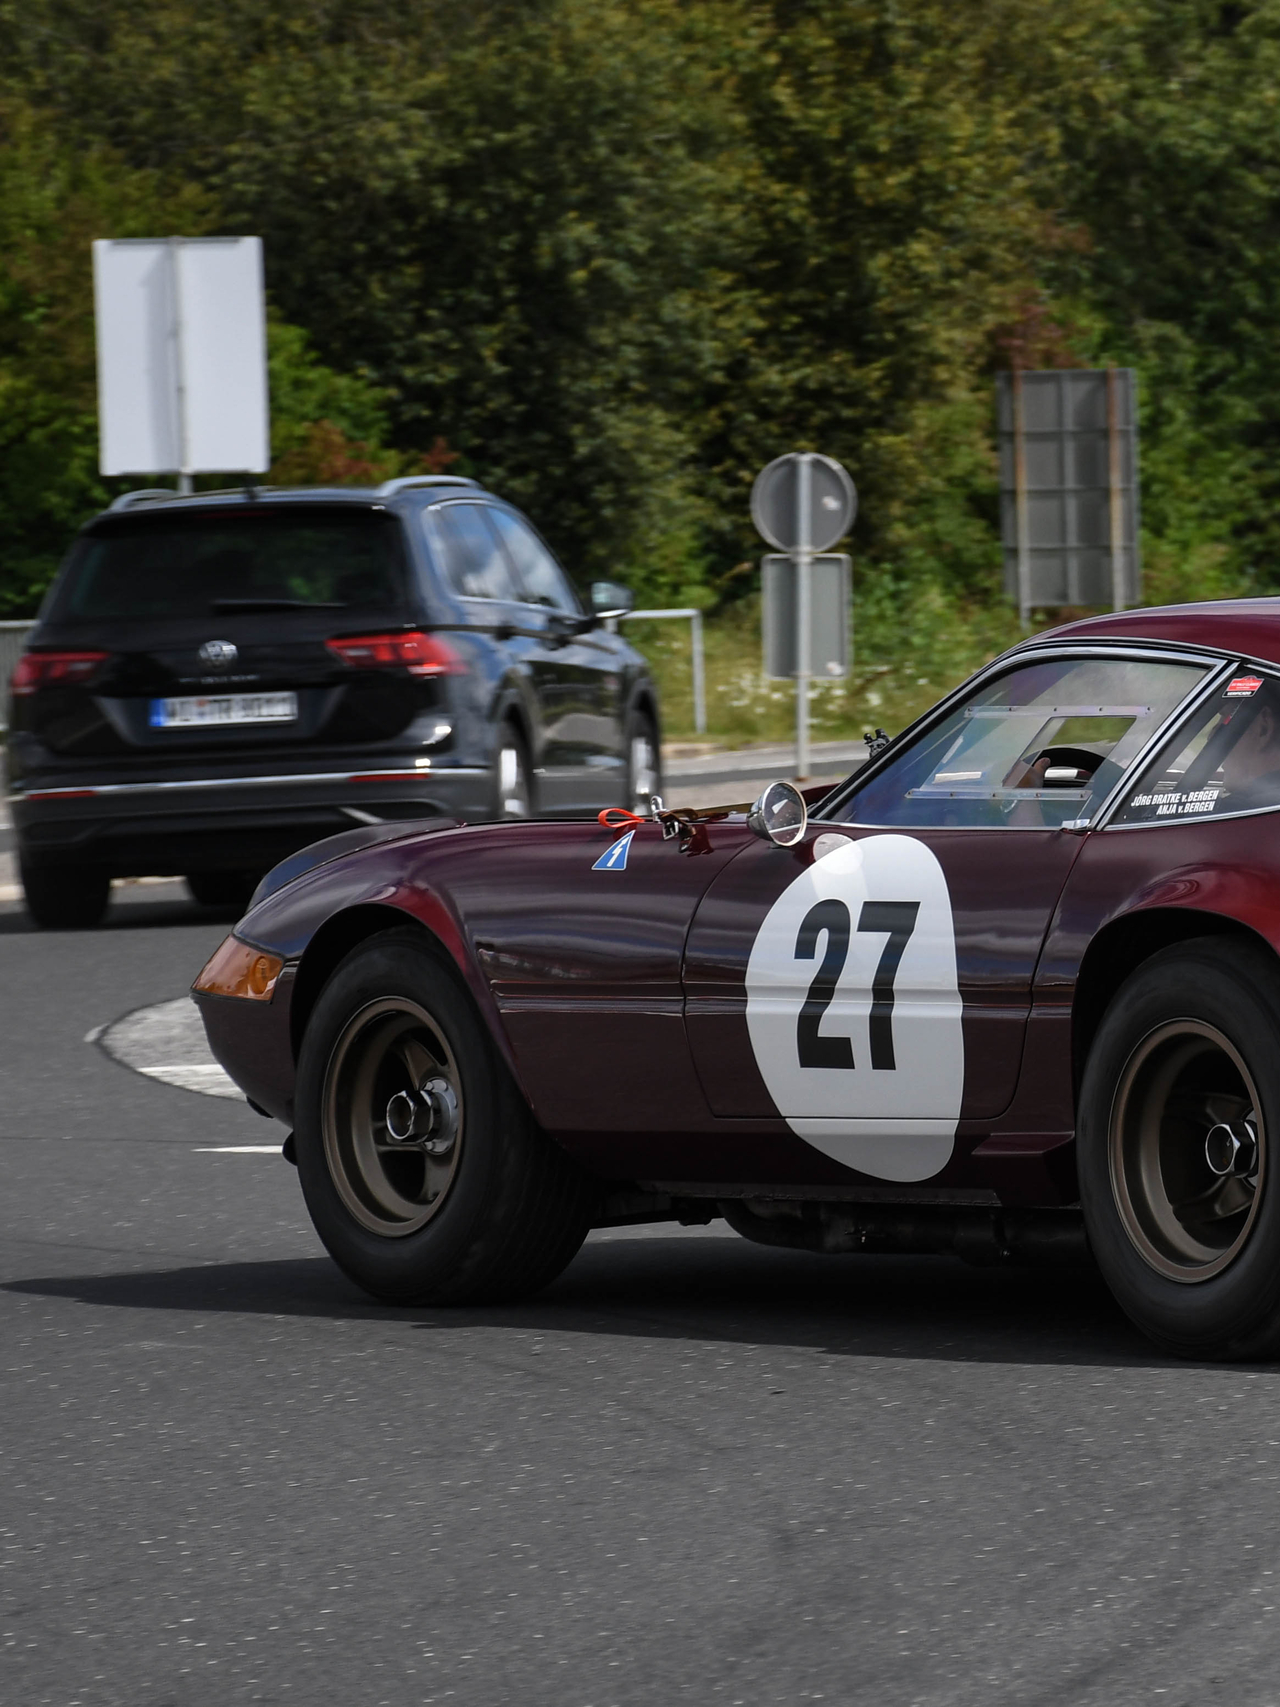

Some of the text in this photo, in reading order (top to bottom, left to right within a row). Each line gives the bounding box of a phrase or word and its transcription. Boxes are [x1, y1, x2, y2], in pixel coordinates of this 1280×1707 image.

[1152, 793, 1181, 805] BRATKE
[1156, 803, 1177, 815] ANJA
[794, 898, 921, 1070] 27
